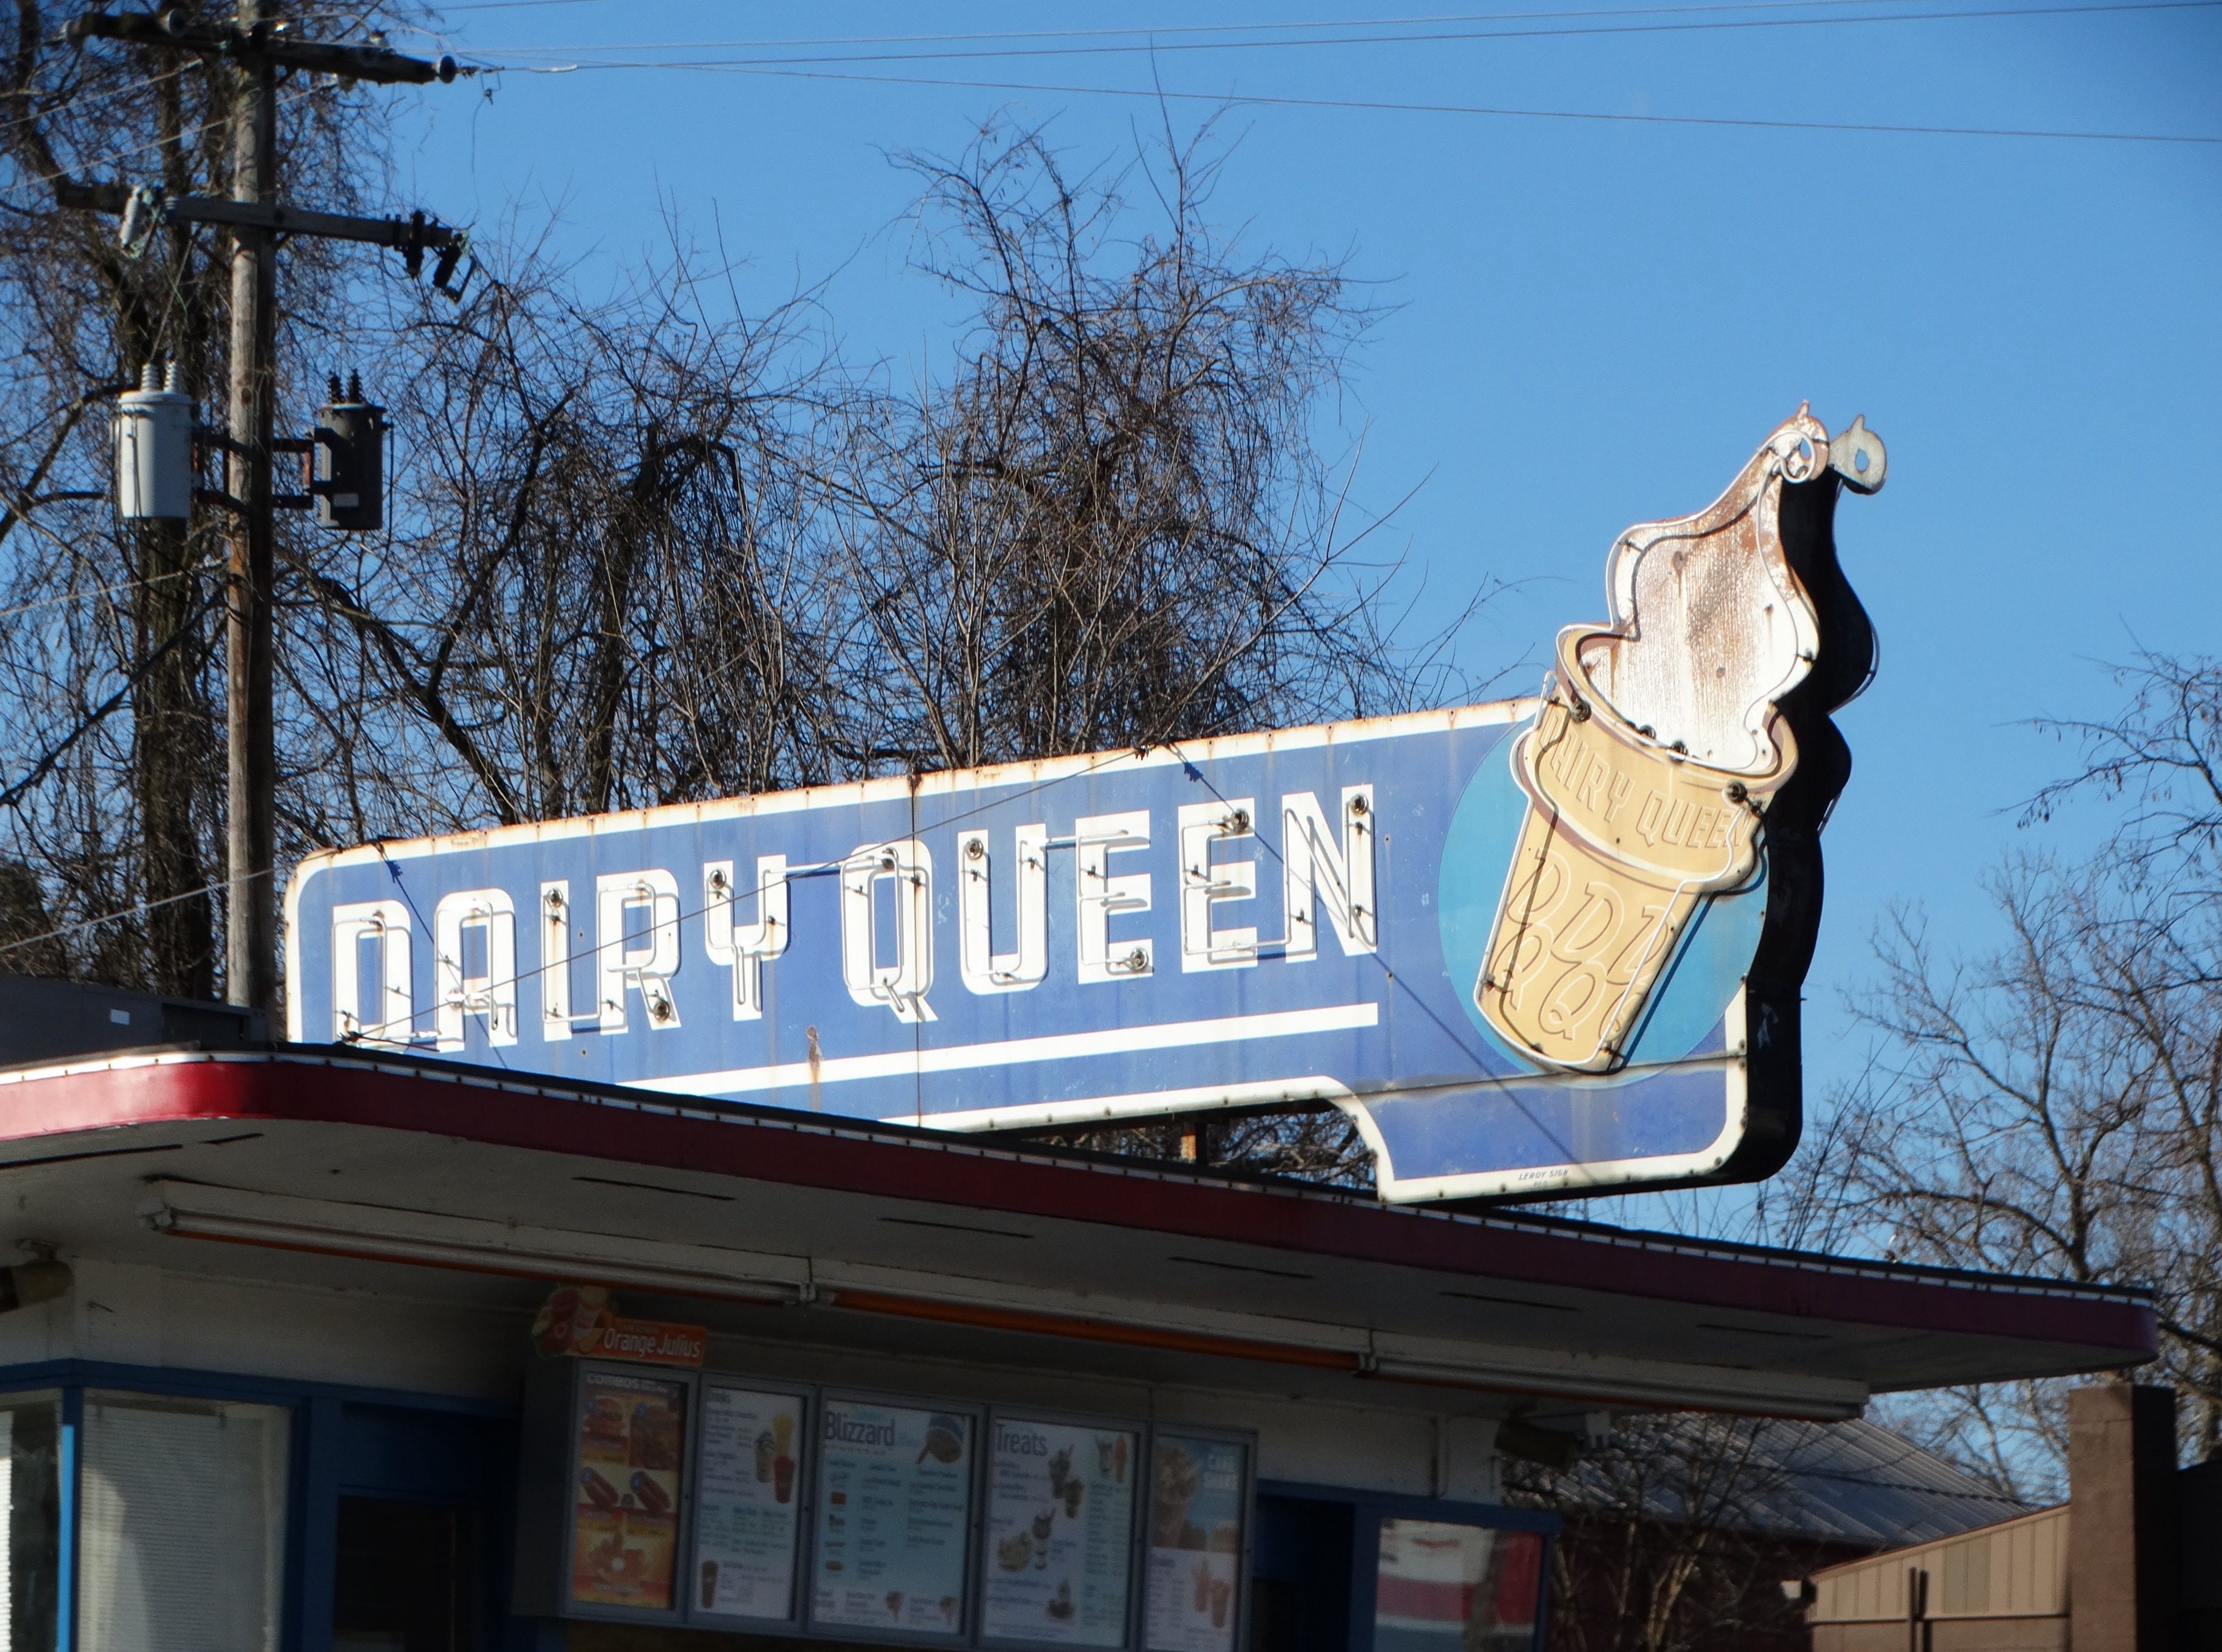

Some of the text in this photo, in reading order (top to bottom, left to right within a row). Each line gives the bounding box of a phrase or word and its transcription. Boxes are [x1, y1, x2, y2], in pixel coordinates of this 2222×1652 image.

[1539, 706, 1754, 847] DAIRY QUEEN
[333, 784, 1377, 1052] DAIRY QUEEN
[1518, 1169, 1569, 1180] LEROY SIGN
[604, 1327, 701, 1358] Orange Julius
[824, 1411, 896, 1446] Blizzard
[995, 1424, 1049, 1457] Treats
